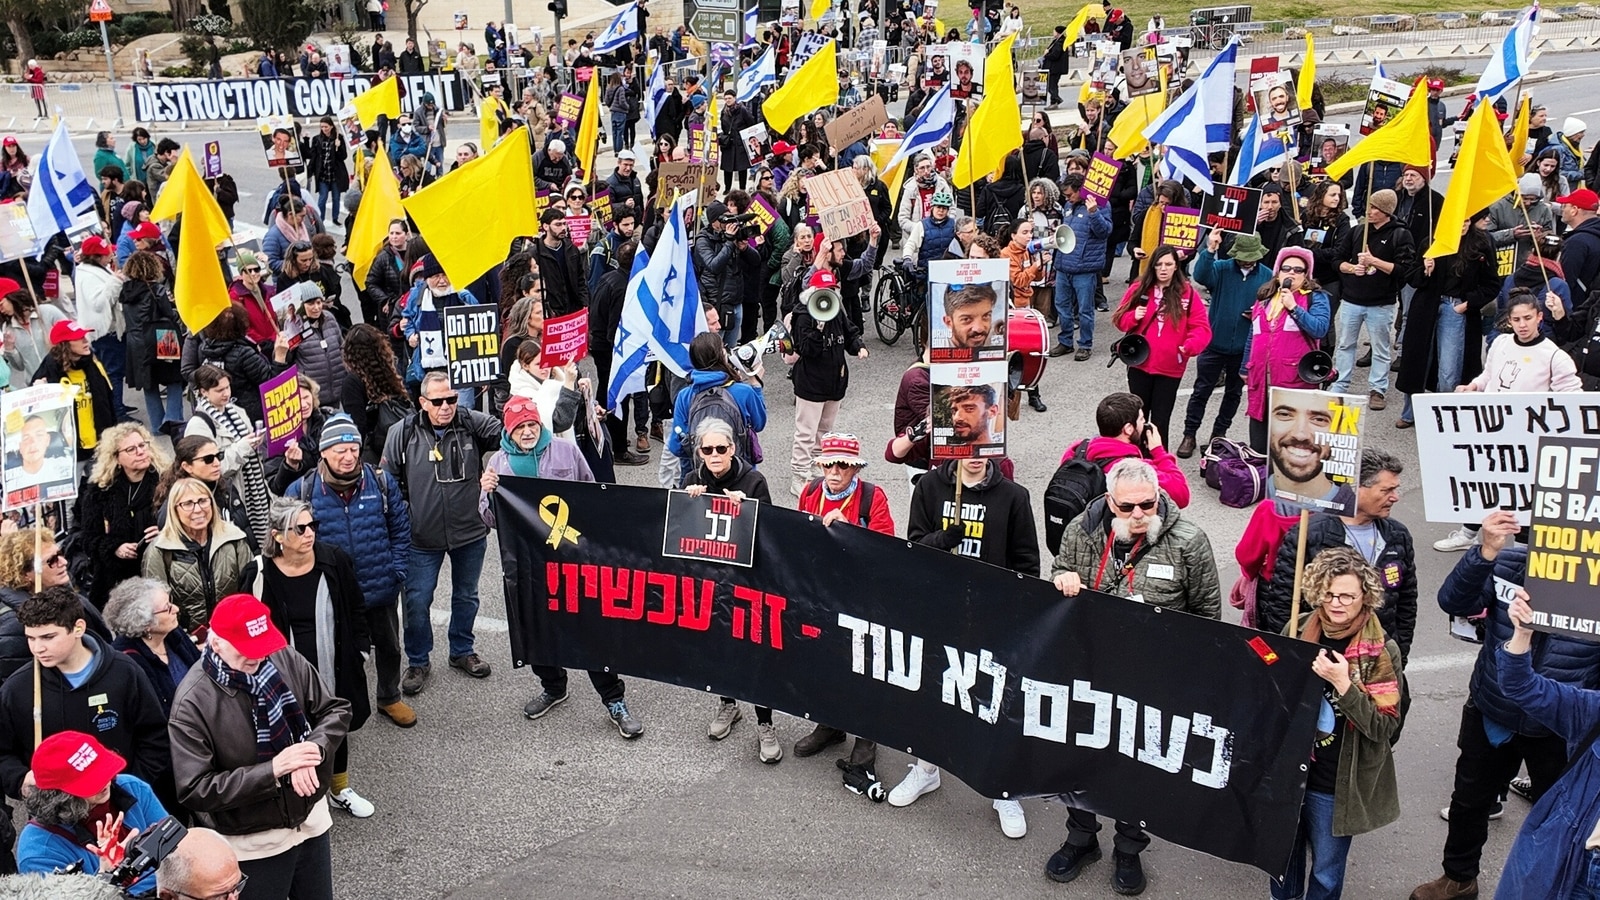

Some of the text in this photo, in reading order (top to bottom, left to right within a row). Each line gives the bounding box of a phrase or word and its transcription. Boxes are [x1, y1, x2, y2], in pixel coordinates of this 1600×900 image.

[137, 79, 288, 121] DESTRUCTION
[1086, 168, 1113, 189] מלאה
[1091, 157, 1119, 177] עסקה
[1218, 195, 1239, 218] כל
[1225, 187, 1248, 202] קודם
[1166, 212, 1200, 226] עסקה
[1164, 225, 1198, 240] מלאה
[447, 310, 496, 336] למה הם
[549, 324, 563, 333] END
[565, 320, 576, 330] THE
[561, 329, 579, 341] BRING
[448, 333, 499, 362] עדיין
[549, 344, 563, 352] ALL
[564, 342, 573, 350] OF
[932, 348, 951, 359] HOME
[952, 347, 973, 359] NOW!
[451, 357, 500, 385] בעזה?
[264, 375, 298, 409] עסקה
[267, 394, 301, 428] מלאה
[1328, 401, 1361, 435] אל
[1432, 405, 1513, 433] ישרדו
[1525, 398, 1571, 434] לא
[933, 427, 954, 436] BRING
[1314, 432, 1358, 449] תשאירו
[934, 446, 953, 455] HOME
[954, 445, 973, 455] NOW!
[1331, 448, 1357, 463] אותי
[1453, 444, 1530, 473] נחזיר
[1320, 460, 1355, 477] מאחור
[1449, 476, 1535, 512] עכשיו!
[1535, 491, 1562, 519] IS
[712, 497, 741, 519] קודם
[960, 502, 986, 521] למה
[705, 509, 732, 542] כל
[1533, 524, 1577, 551] TOO
[680, 537, 737, 560] החטופים!
[1528, 551, 1582, 583] NOT
[546, 561, 716, 632] עכשיו!
[732, 584, 788, 651] זה
[1551, 614, 1569, 630] THE
[1570, 617, 1595, 635] LAST
[836, 612, 924, 693] עוד
[941, 644, 1008, 725] לא
[1020, 678, 1234, 791] לעולם
